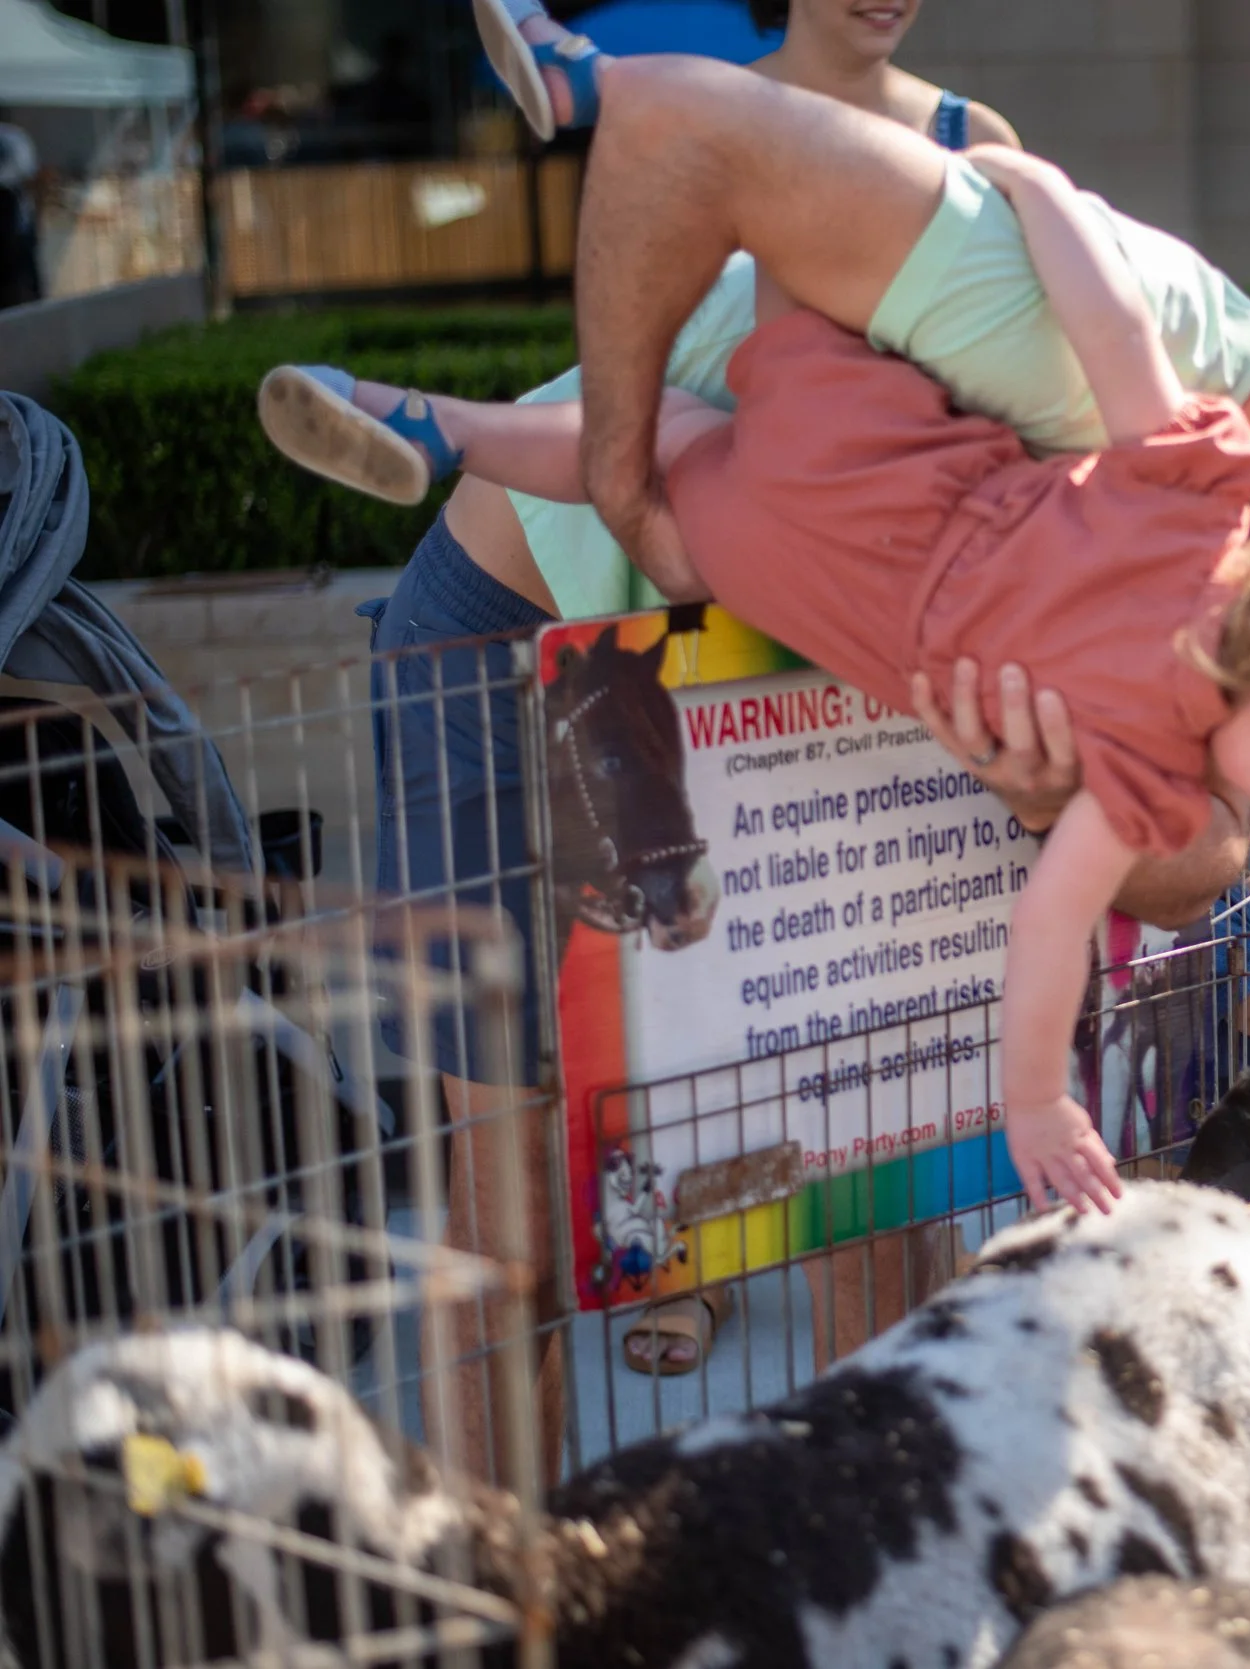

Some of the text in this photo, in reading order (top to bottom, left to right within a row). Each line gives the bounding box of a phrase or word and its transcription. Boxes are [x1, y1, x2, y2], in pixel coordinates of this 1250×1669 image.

[685, 684, 853, 750] WARNING:
[726, 724, 933, 777] (Chapter 87, Civil Practic
[733, 767, 990, 838] An equine professiona
[724, 859, 762, 896] not
[768, 846, 829, 888] liable
[836, 840, 867, 874] for
[875, 837, 900, 867] an
[907, 824, 967, 866] injury
[973, 816, 1000, 850] to,
[727, 861, 1028, 951] the death of a participant in
[741, 917, 1012, 1010] equine activities resultin
[747, 1026, 799, 1059] from
[807, 1010, 842, 1044] the
[849, 985, 937, 1034] inherent
[945, 974, 995, 1011] risks
[798, 1058, 872, 1106] equine
[803, 1145, 848, 1169] Pony
